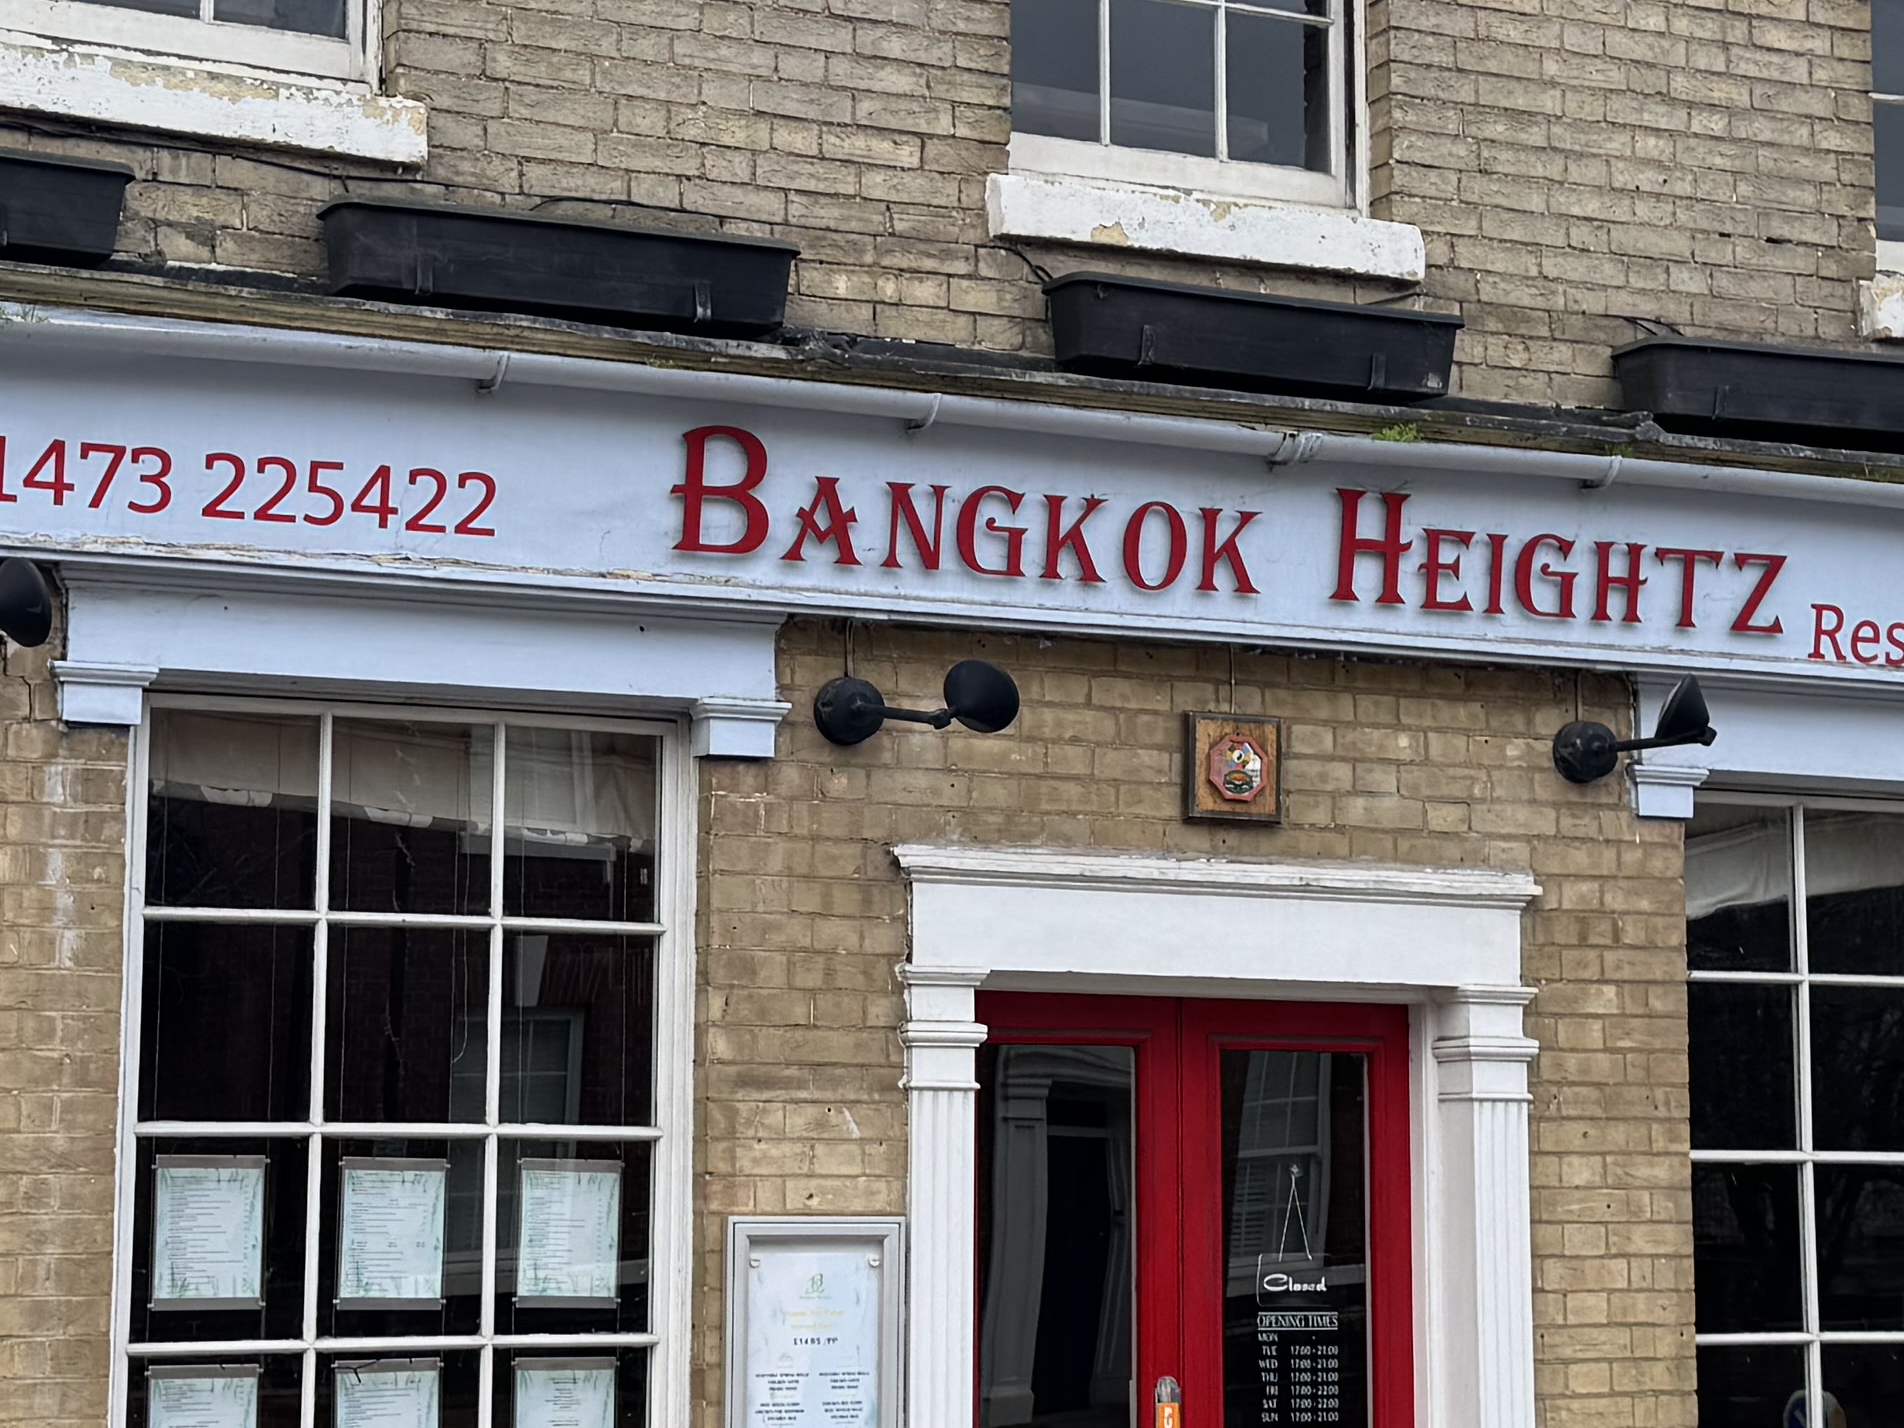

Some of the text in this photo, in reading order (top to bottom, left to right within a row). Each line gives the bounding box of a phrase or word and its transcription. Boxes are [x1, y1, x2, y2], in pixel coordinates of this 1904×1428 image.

[201, 452, 496, 537] 225422
[671, 424, 1788, 636] BANGKOK HEIGHTZ
[1263, 1273, 1327, 1292] Closed
[1257, 1315, 1338, 1327] OPENING TIMES
